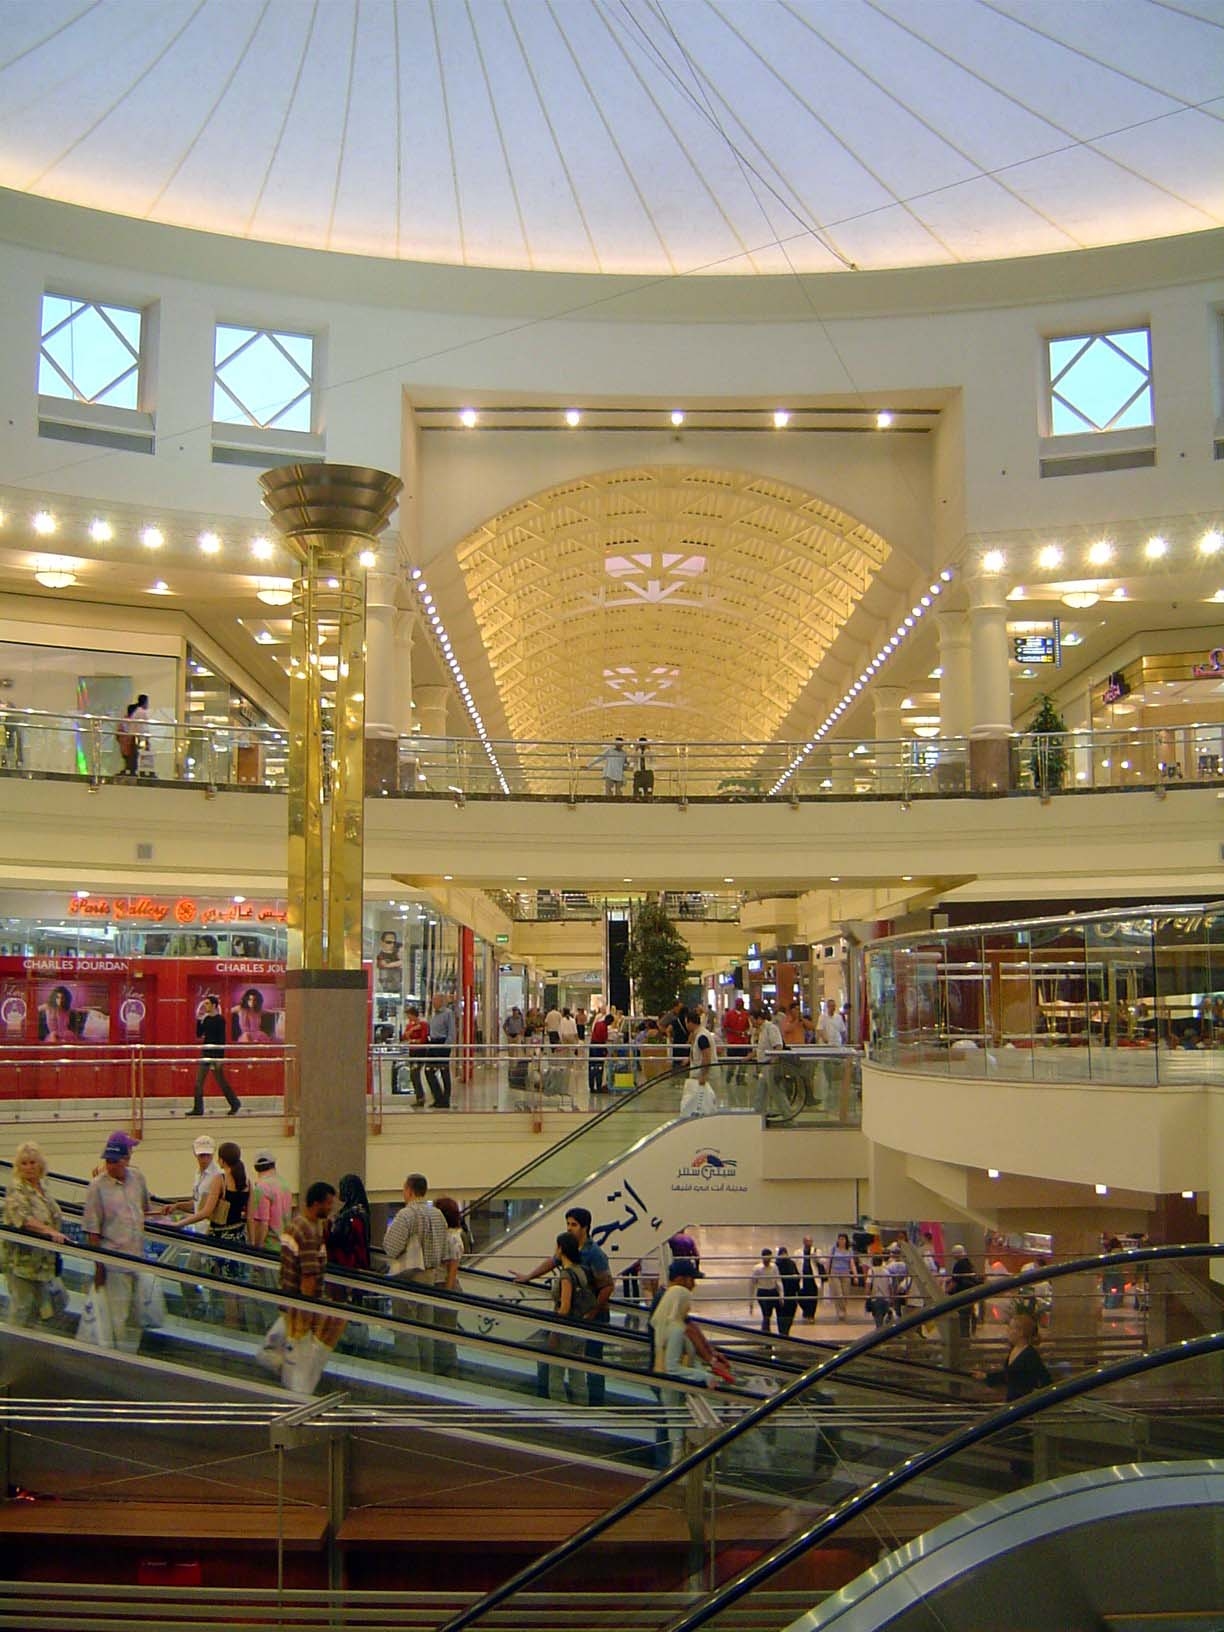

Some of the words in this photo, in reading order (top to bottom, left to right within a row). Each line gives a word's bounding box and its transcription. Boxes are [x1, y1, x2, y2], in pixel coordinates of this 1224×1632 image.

[69, 898, 110, 914] Paris
[113, 898, 169, 921] Gallery
[23, 960, 74, 971] CHARLES
[76, 961, 129, 971] JOURDAN
[216, 963, 265, 973] CHARLES
